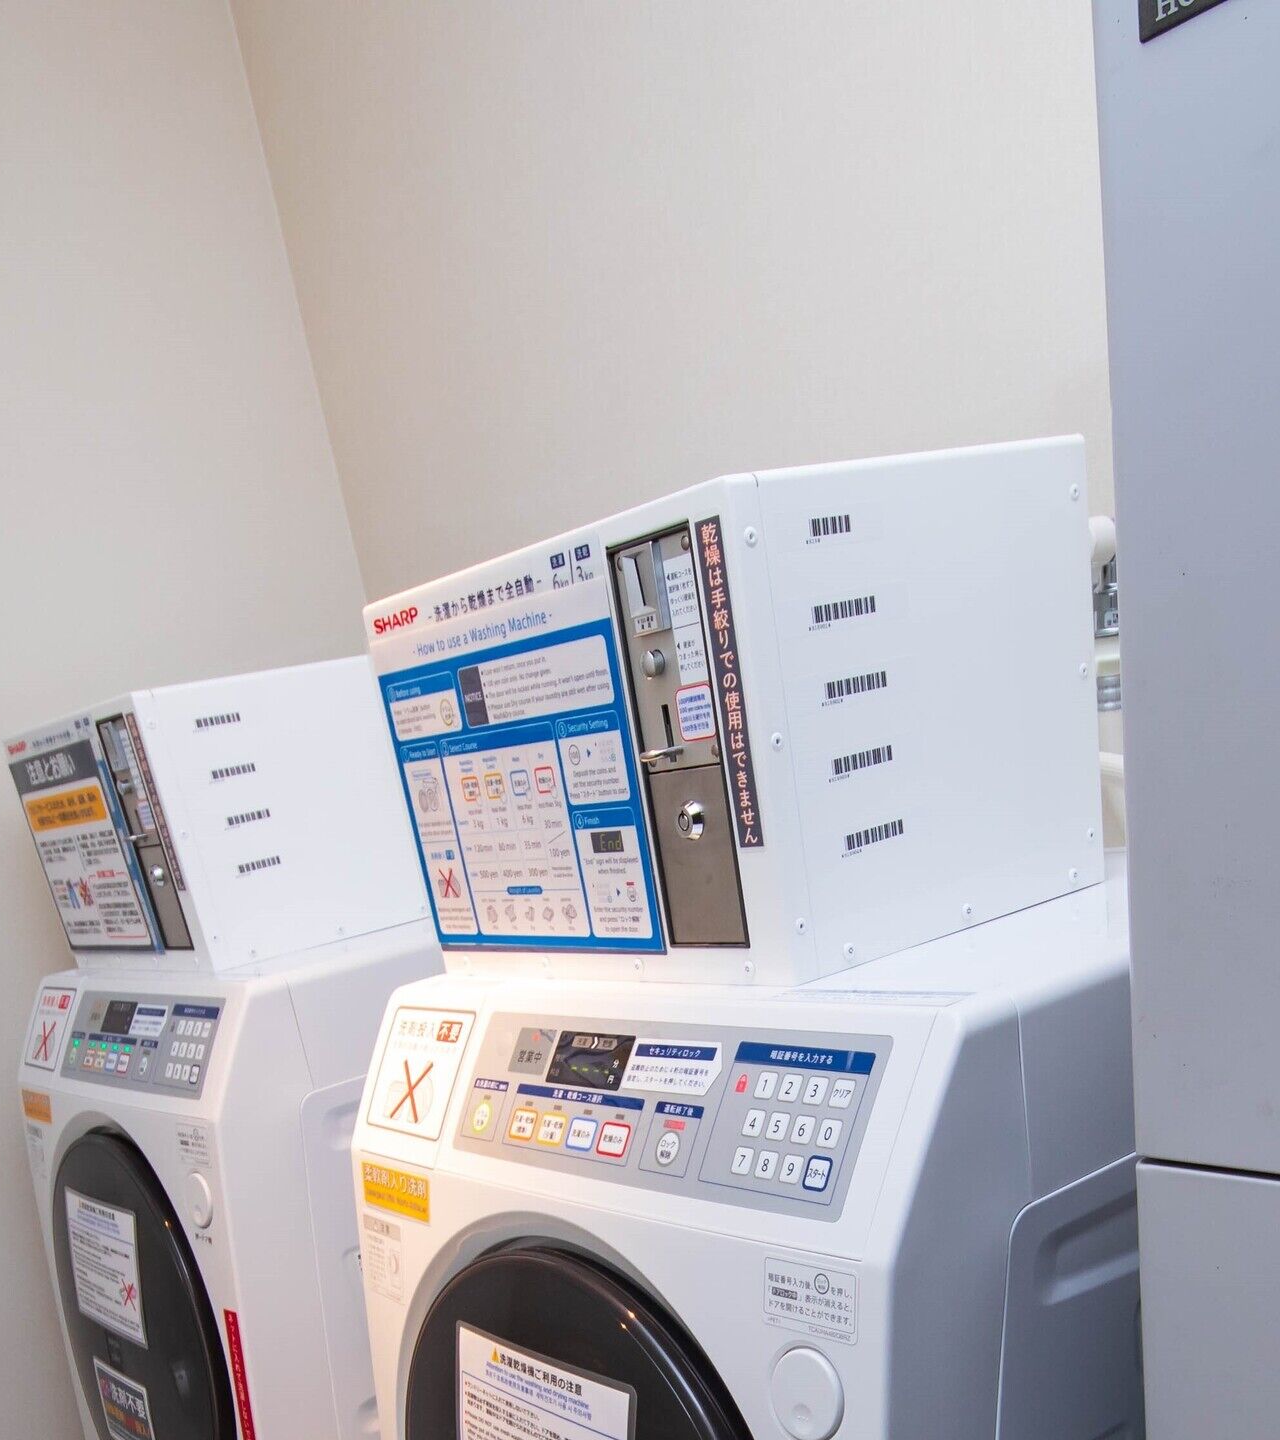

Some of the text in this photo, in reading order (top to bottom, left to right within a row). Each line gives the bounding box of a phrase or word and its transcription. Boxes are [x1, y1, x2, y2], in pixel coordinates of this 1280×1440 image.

[373, 606, 418, 635] SHARP
[416, 611, 546, 656] How to use a Washing Machine
[700, 522, 759, 845] 乾燥は手絞りでの使用はできません
[590, 719, 608, 730] Setting
[438, 1022, 460, 1042] 不要
[518, 1050, 543, 1064] 営業中
[649, 1047, 701, 1057] セキュリティロック
[770, 1049, 833, 1065] 暗証番号を入力する
[612, 1059, 620, 1068] 分
[607, 1075, 615, 1084] 円
[762, 1079, 768, 1091] 1
[785, 1081, 793, 1095] 2
[810, 1084, 819, 1098] 3
[832, 1089, 852, 1099] クリア
[553, 1090, 603, 1103] 洗濯・乾燥コース選択
[664, 1103, 694, 1115] 運転終了後
[749, 1117, 757, 1130] 4
[773, 1120, 781, 1133] 5
[798, 1123, 806, 1137] 6
[572, 1129, 590, 1139] 洗濯のみ
[603, 1133, 623, 1144] 乾燥のみ
[824, 1127, 832, 1141] 0
[659, 1139, 676, 1149] ロック
[738, 1154, 746, 1167] 7
[761, 1158, 769, 1172] 8
[787, 1162, 795, 1176] 9
[807, 1168, 826, 1179] スタート
[831, 1286, 853, 1299] を押し、
[768, 1300, 852, 1327] ドアを開けることができます。
[500, 1352, 582, 1397] 洗濯乾燥機ご利用の注意
